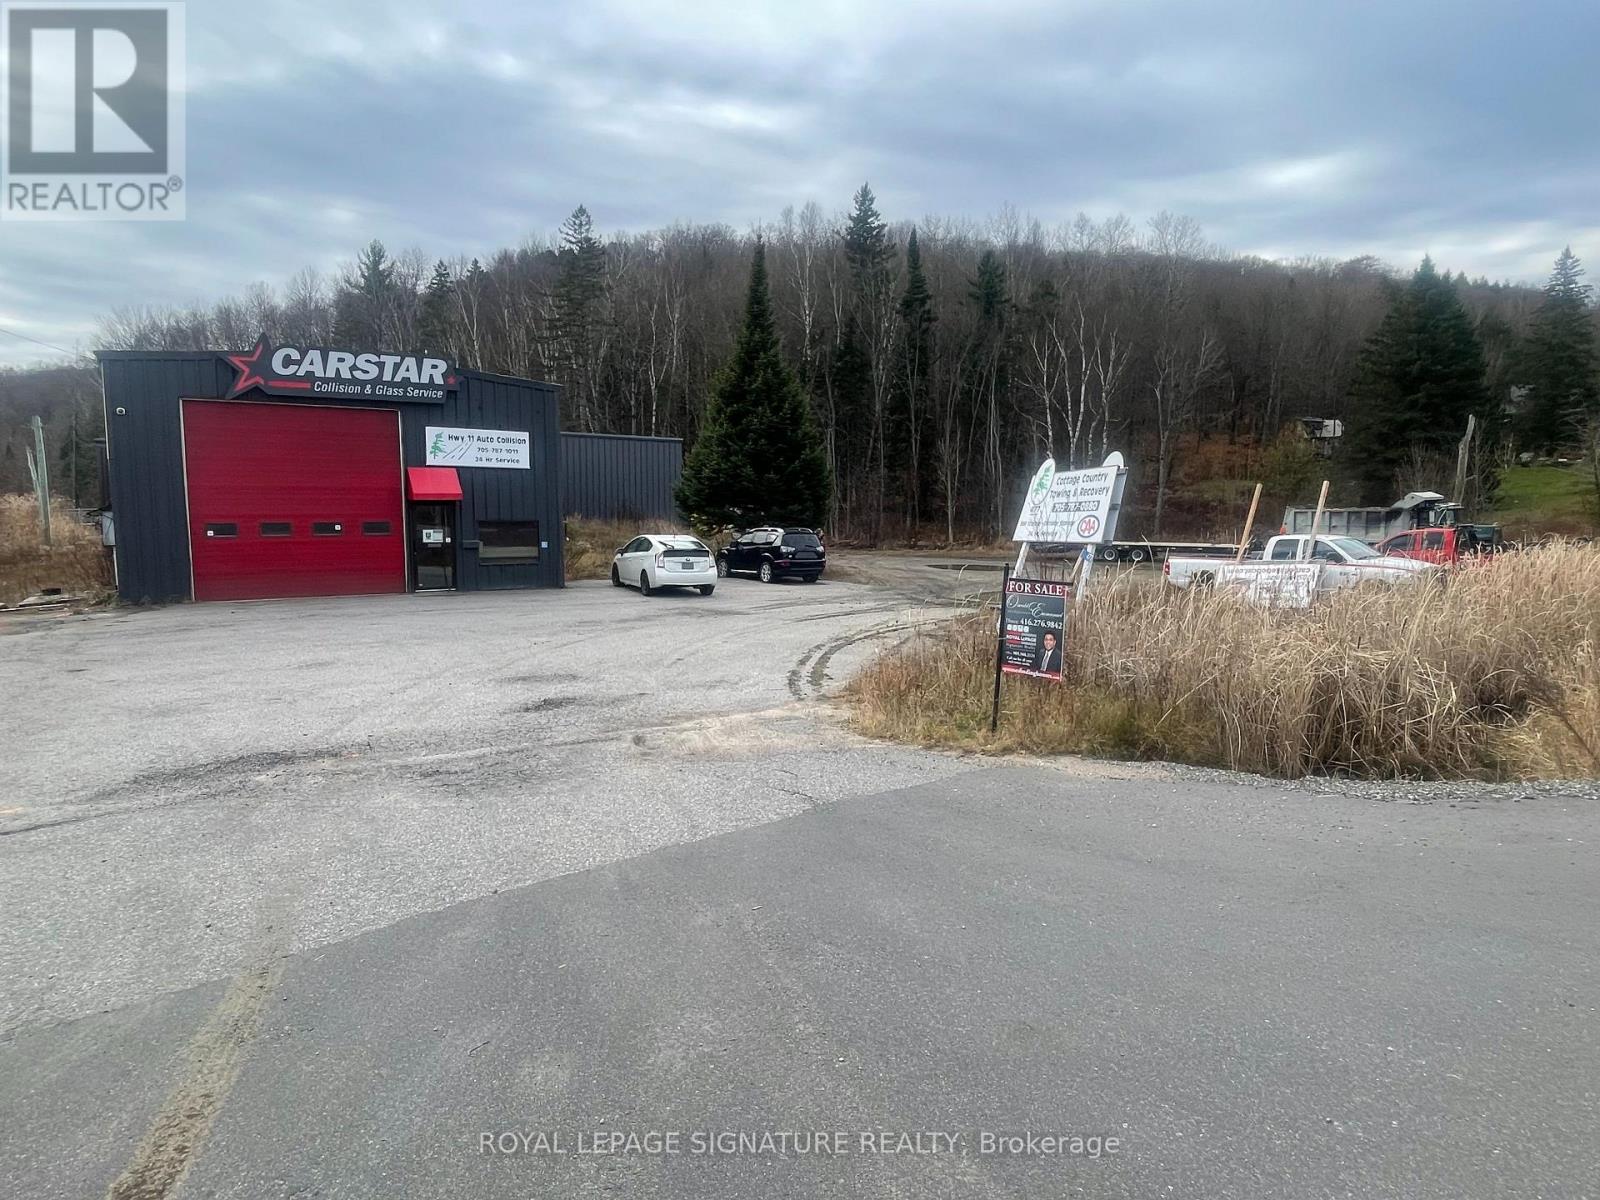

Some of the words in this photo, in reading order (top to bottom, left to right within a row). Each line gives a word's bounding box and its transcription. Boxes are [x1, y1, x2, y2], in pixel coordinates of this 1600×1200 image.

[271, 348, 447, 385] CARSTAR
[314, 381, 361, 394] Collision
[364, 384, 372, 394] &
[375, 385, 404, 396] Glass
[407, 386, 443, 399] Service
[448, 434, 464, 443] Hwy
[477, 435, 494, 443] Auto
[497, 436, 527, 445] Collision
[1056, 475, 1081, 486] Cottage
[1082, 473, 1109, 484] Country
[1079, 486, 1110, 498] Recovery
[1009, 581, 1031, 593] FOR
[1034, 583, 1063, 596] SALE
